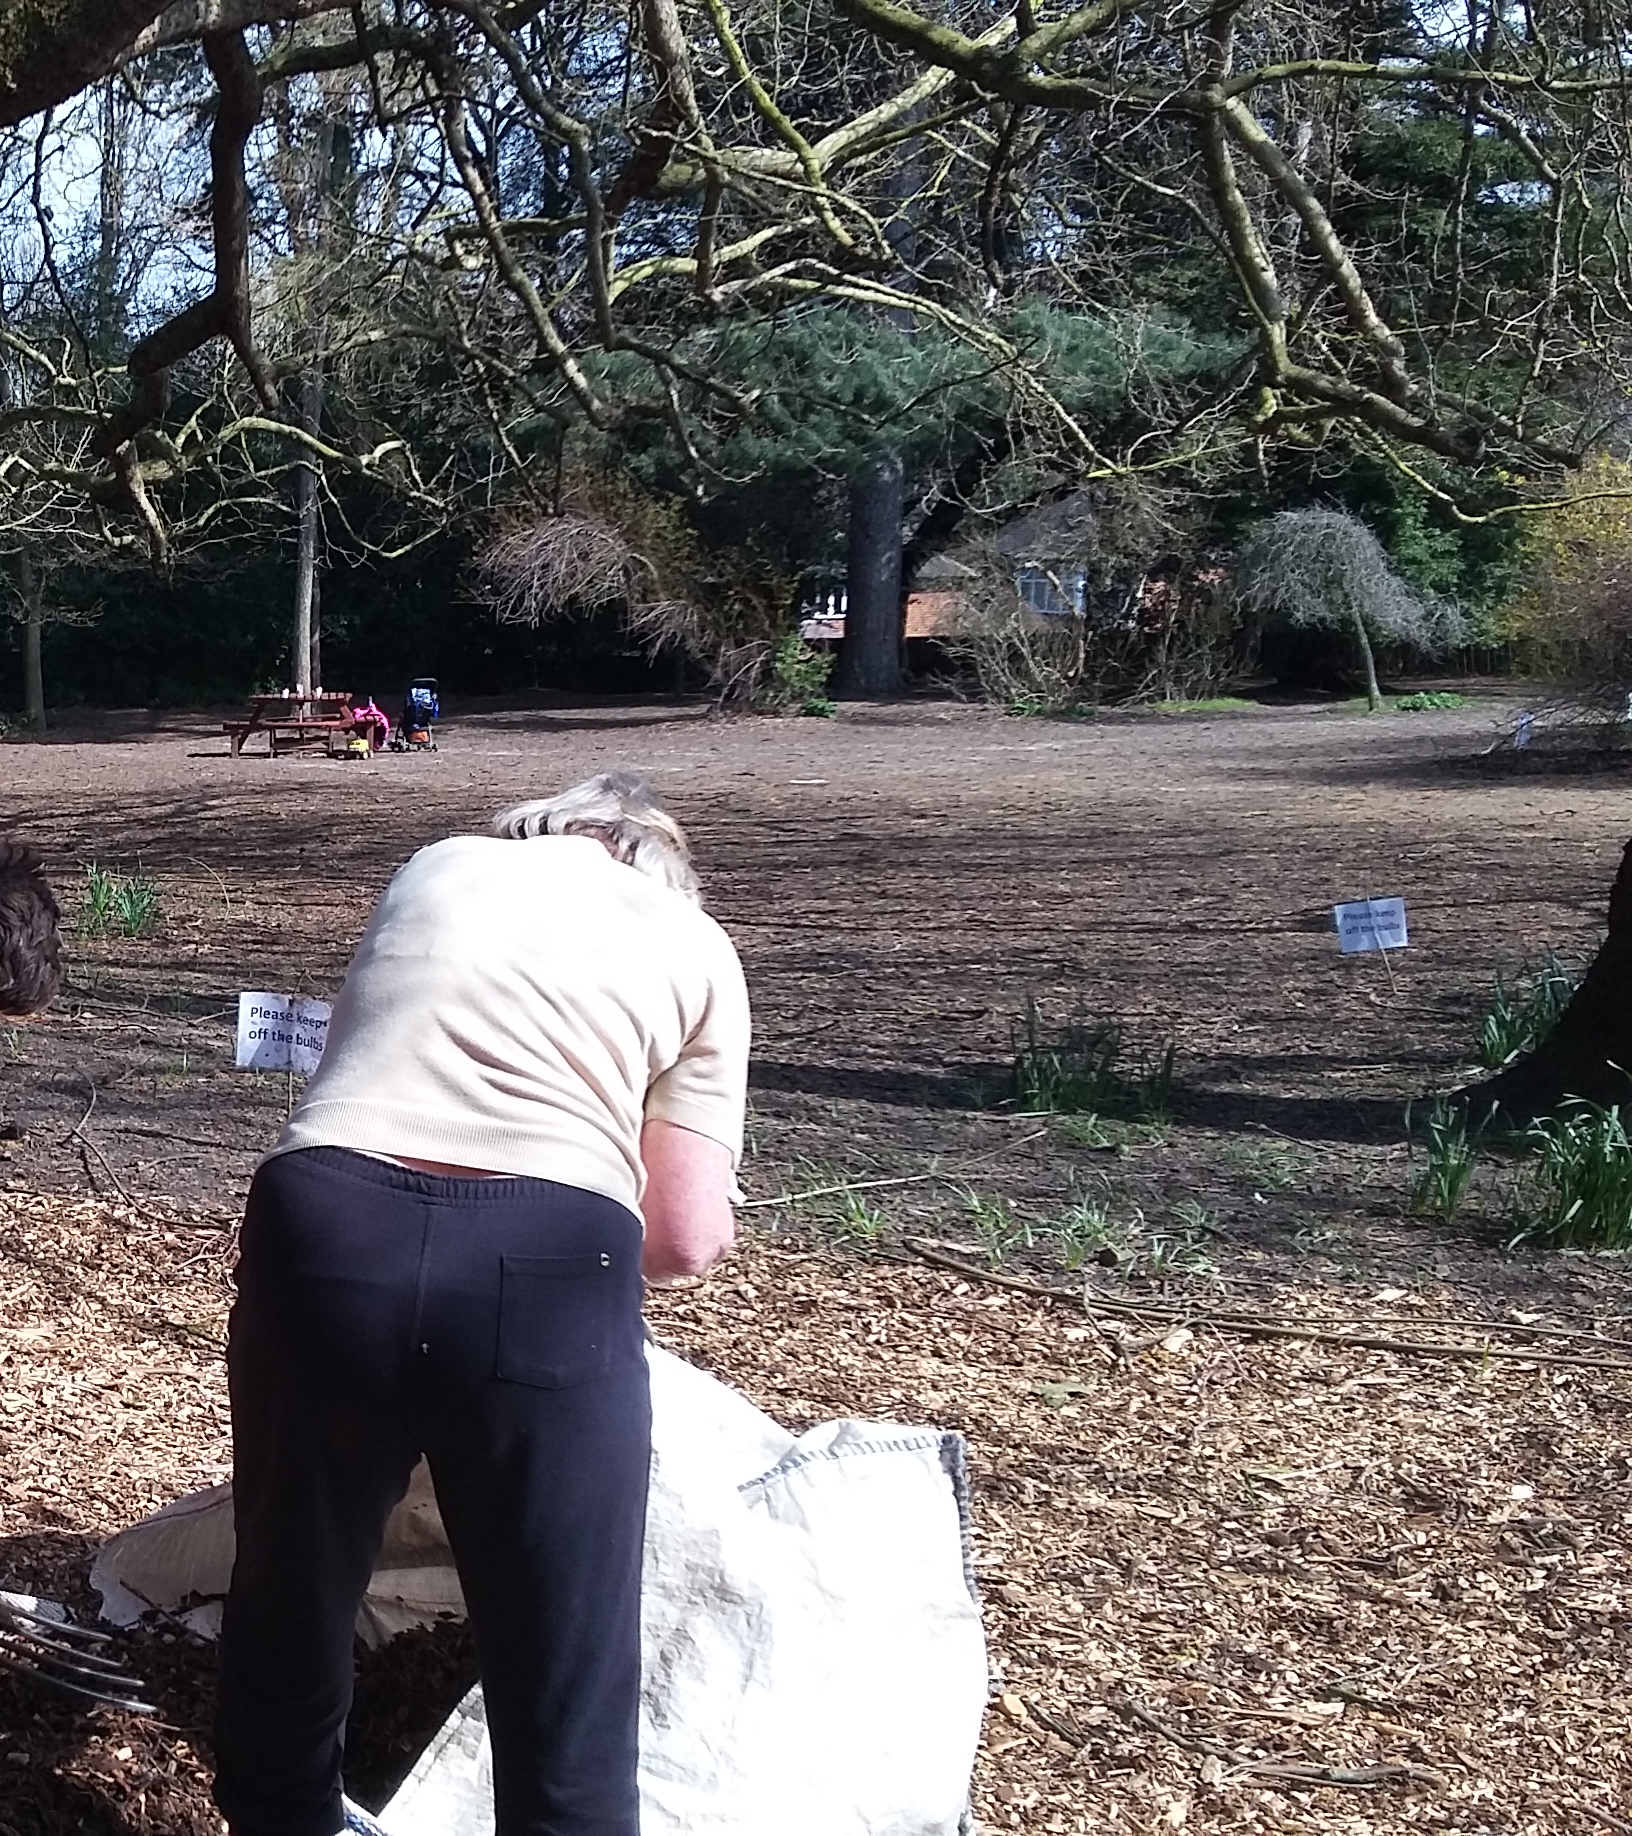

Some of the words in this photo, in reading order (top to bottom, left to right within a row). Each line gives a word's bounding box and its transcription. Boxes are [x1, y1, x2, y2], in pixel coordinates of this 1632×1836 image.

[250, 1006, 294, 1023] Please
[296, 1012, 323, 1030] keep
[248, 1027, 269, 1040] off
[271, 1029, 293, 1044] the
[295, 1033, 324, 1052] bulbs
